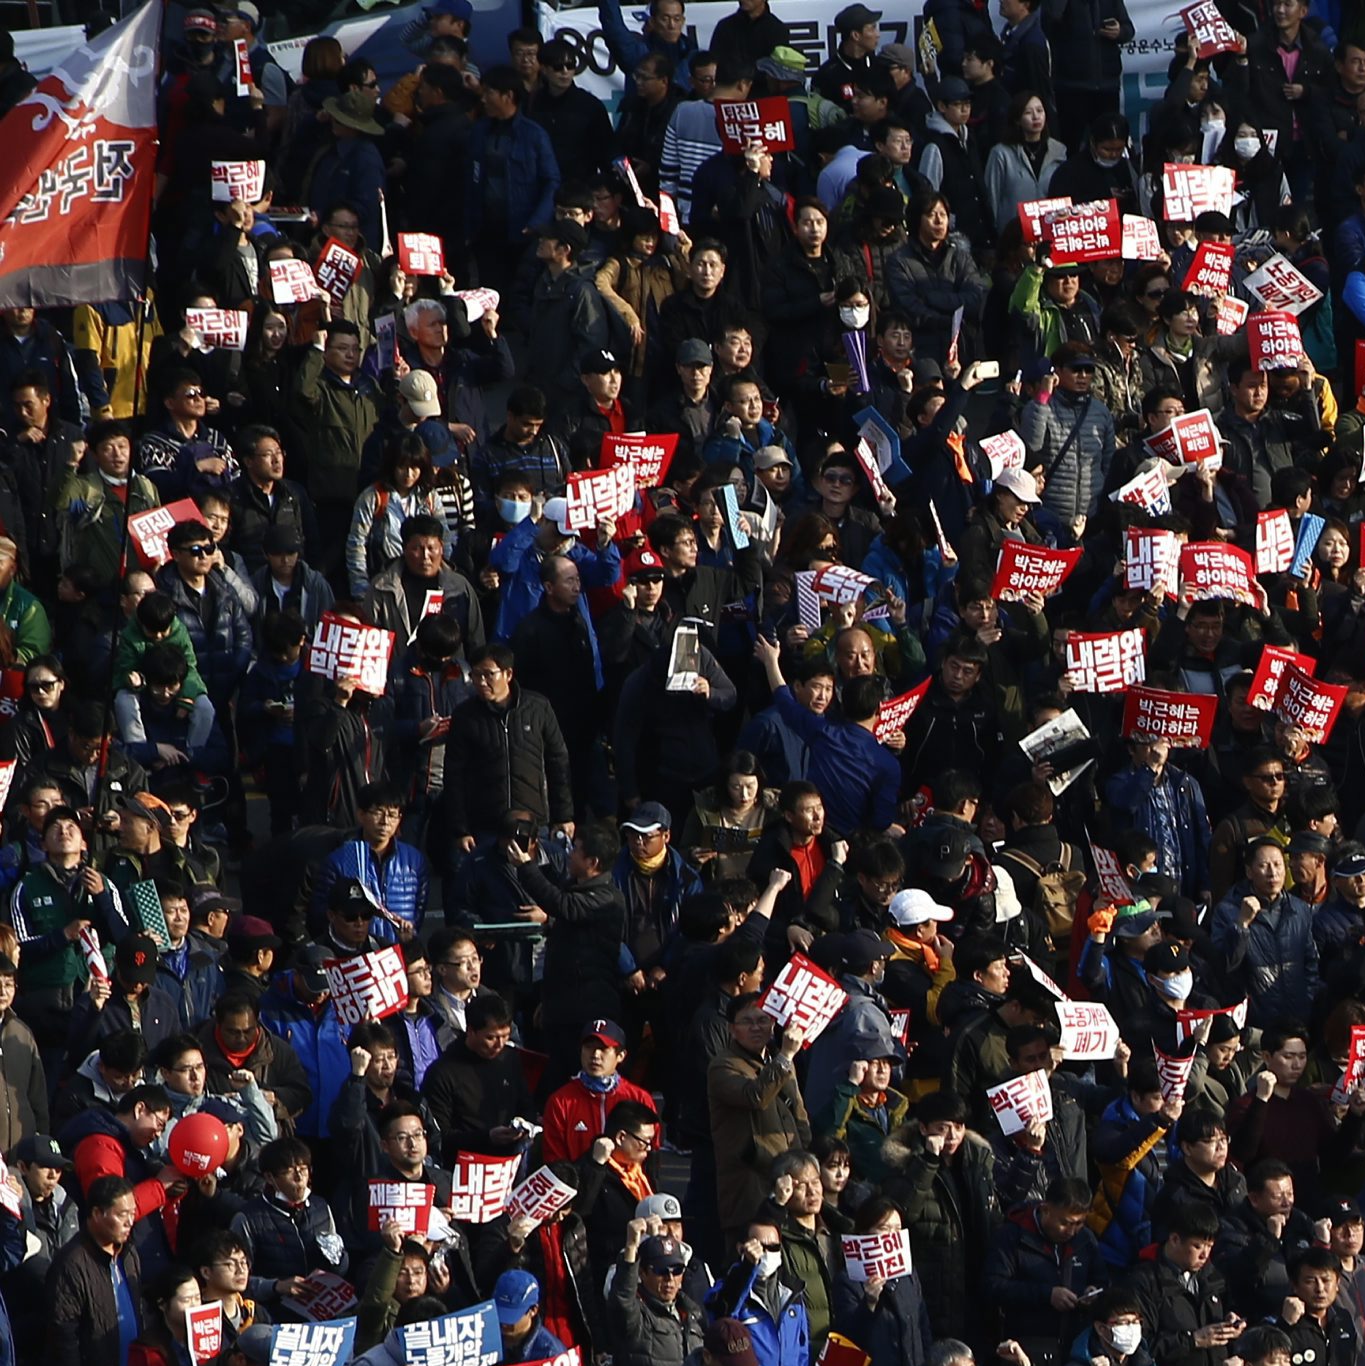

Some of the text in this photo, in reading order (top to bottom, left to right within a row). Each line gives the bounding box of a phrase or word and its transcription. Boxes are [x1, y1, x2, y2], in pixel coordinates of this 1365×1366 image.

[189, 311, 245, 331] 박근혜
[614, 445, 666, 463] 박근혜는
[1195, 552, 1245, 573] 박근혜는
[1196, 568, 1250, 590] 하야하라
[313, 624, 390, 654] 내려와
[1067, 634, 1144, 668] 내려와
[1068, 662, 1144, 692] 박근혜
[1289, 675, 1335, 711] 박근혜는
[1138, 699, 1199, 718] 박근혜는
[1283, 692, 1329, 728] 하야하라
[1138, 715, 1198, 736] 하야하라
[775, 962, 847, 1010] 내려와
[1062, 1007, 1110, 1029] 노동개악
[1074, 1030, 1107, 1052] 폐기
[372, 1183, 425, 1205] 재벌도
[844, 1233, 902, 1257] 박근혜
[277, 1323, 343, 1351] 끝내자
[405, 1315, 484, 1348] 끝내자
